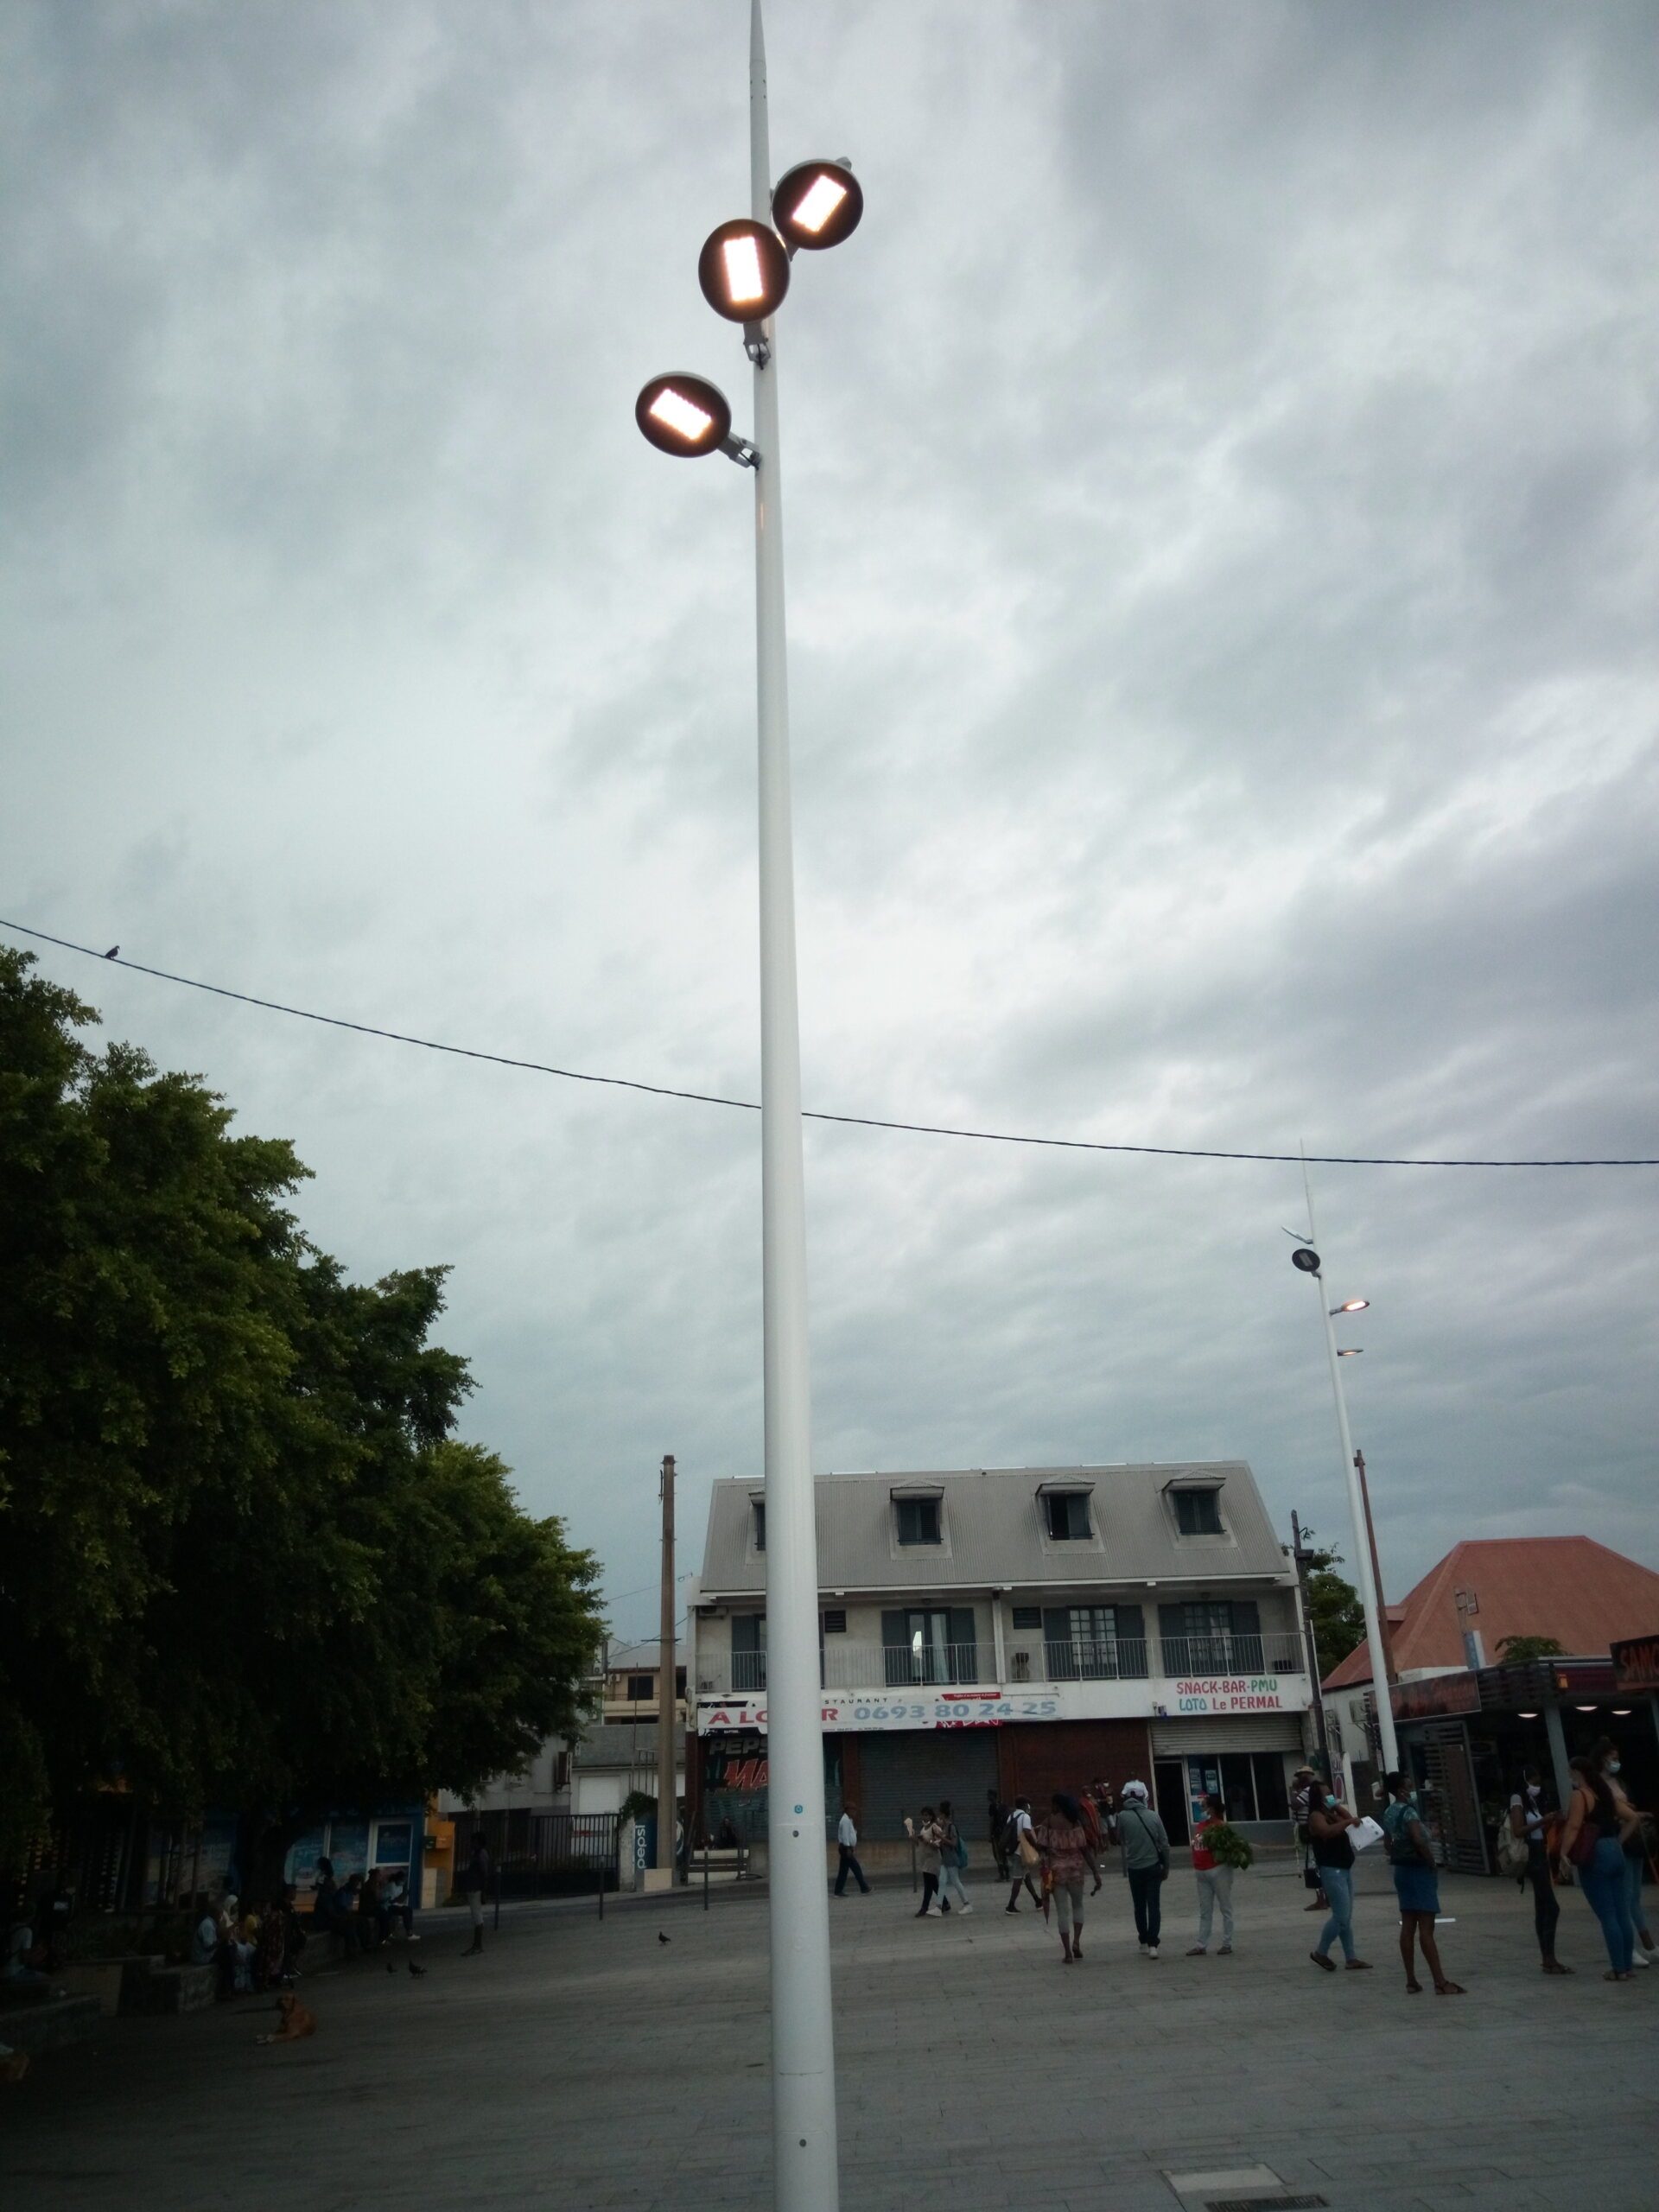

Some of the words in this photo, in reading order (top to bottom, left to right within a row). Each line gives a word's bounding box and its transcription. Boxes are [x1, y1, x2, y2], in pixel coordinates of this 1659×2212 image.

[708, 1711, 731, 1725] A
[854, 1705, 926, 1720] 0693
[934, 1703, 969, 1719] 80
[977, 1702, 1014, 1716] 24
[1021, 1700, 1057, 1715] 25
[1179, 1697, 1207, 1712] LOTO
[1212, 1699, 1227, 1711] Le
[1230, 1695, 1283, 1710] PERMAL
[635, 1824, 647, 1870] pepsi
